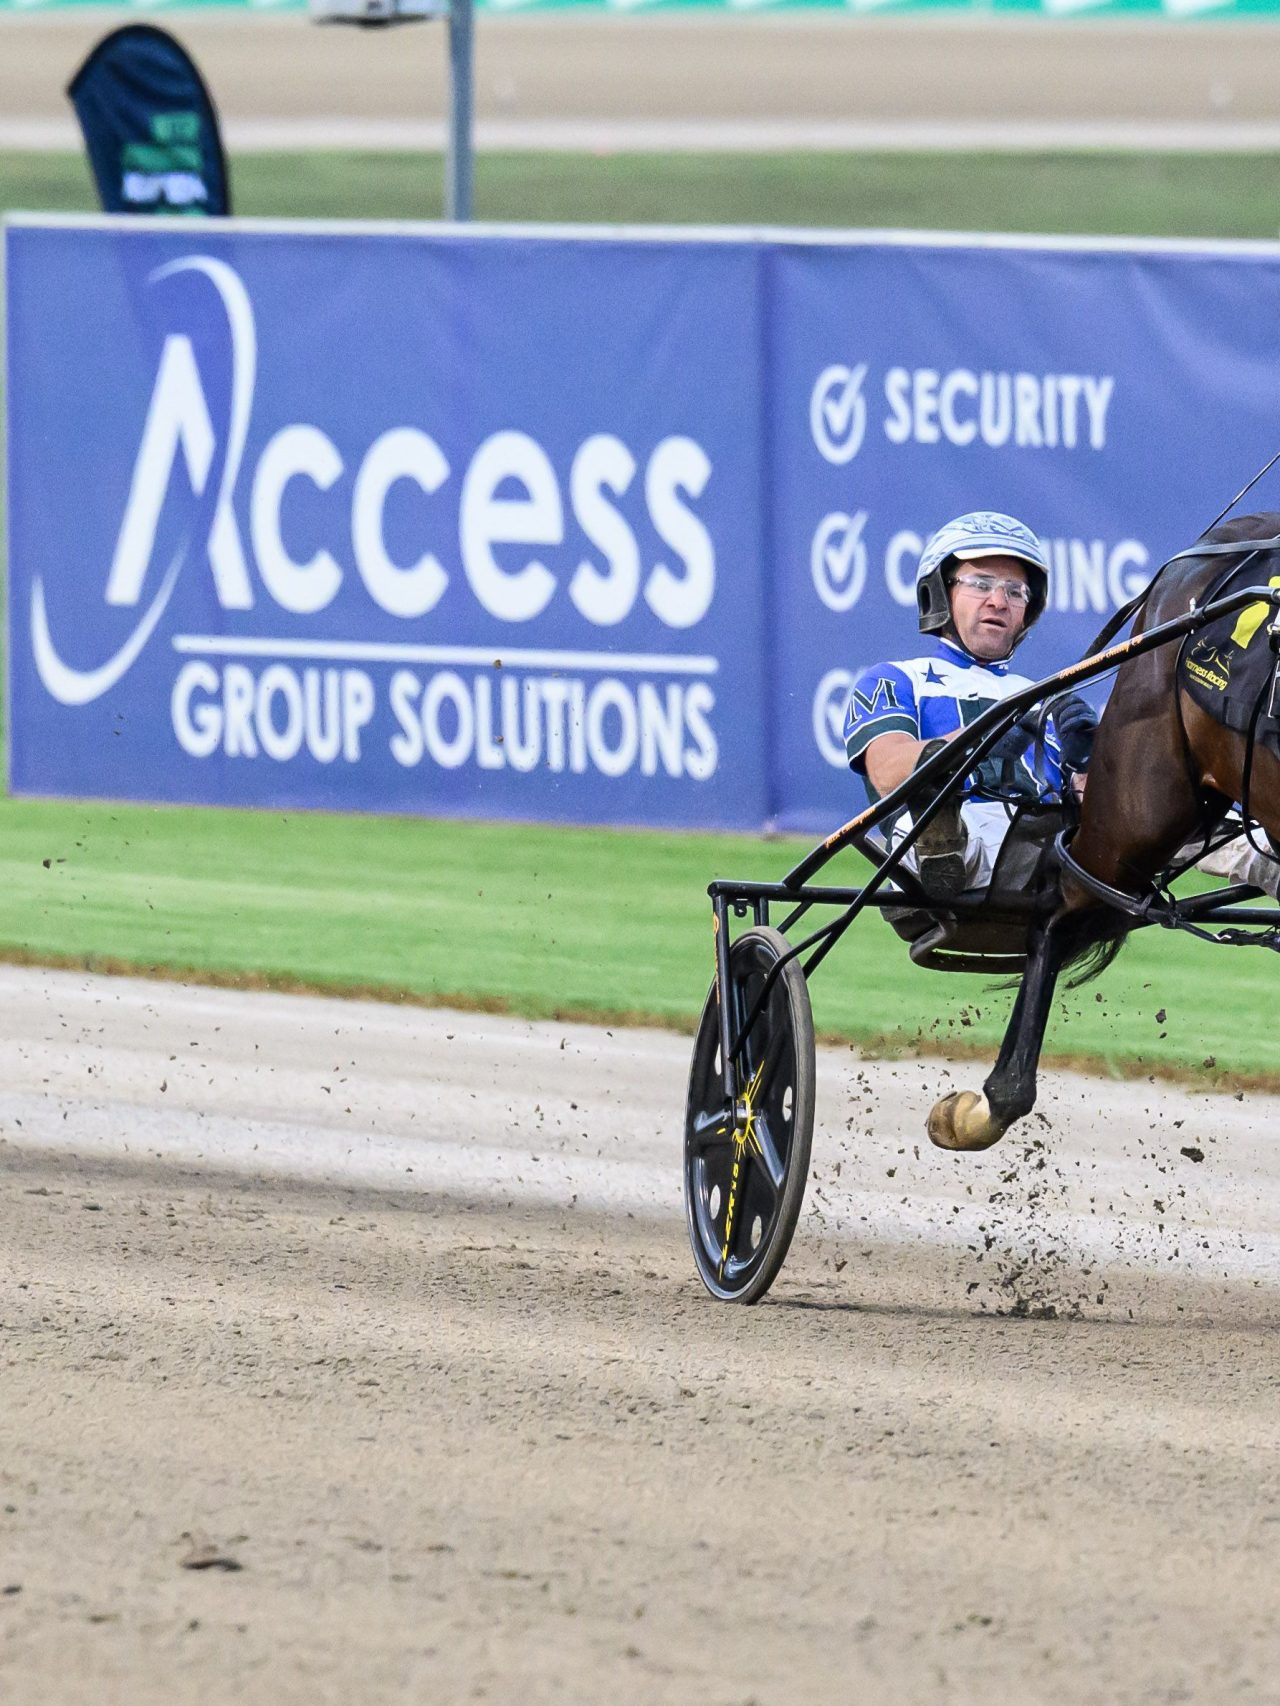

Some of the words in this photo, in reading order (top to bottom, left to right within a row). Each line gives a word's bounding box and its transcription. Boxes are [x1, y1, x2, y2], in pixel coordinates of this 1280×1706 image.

[884, 366, 1115, 450] SECURITY
[105, 334, 716, 629] Access
[171, 661, 375, 764] GROUP
[389, 669, 719, 781] SOLUTIONS
[847, 677, 905, 729] M
